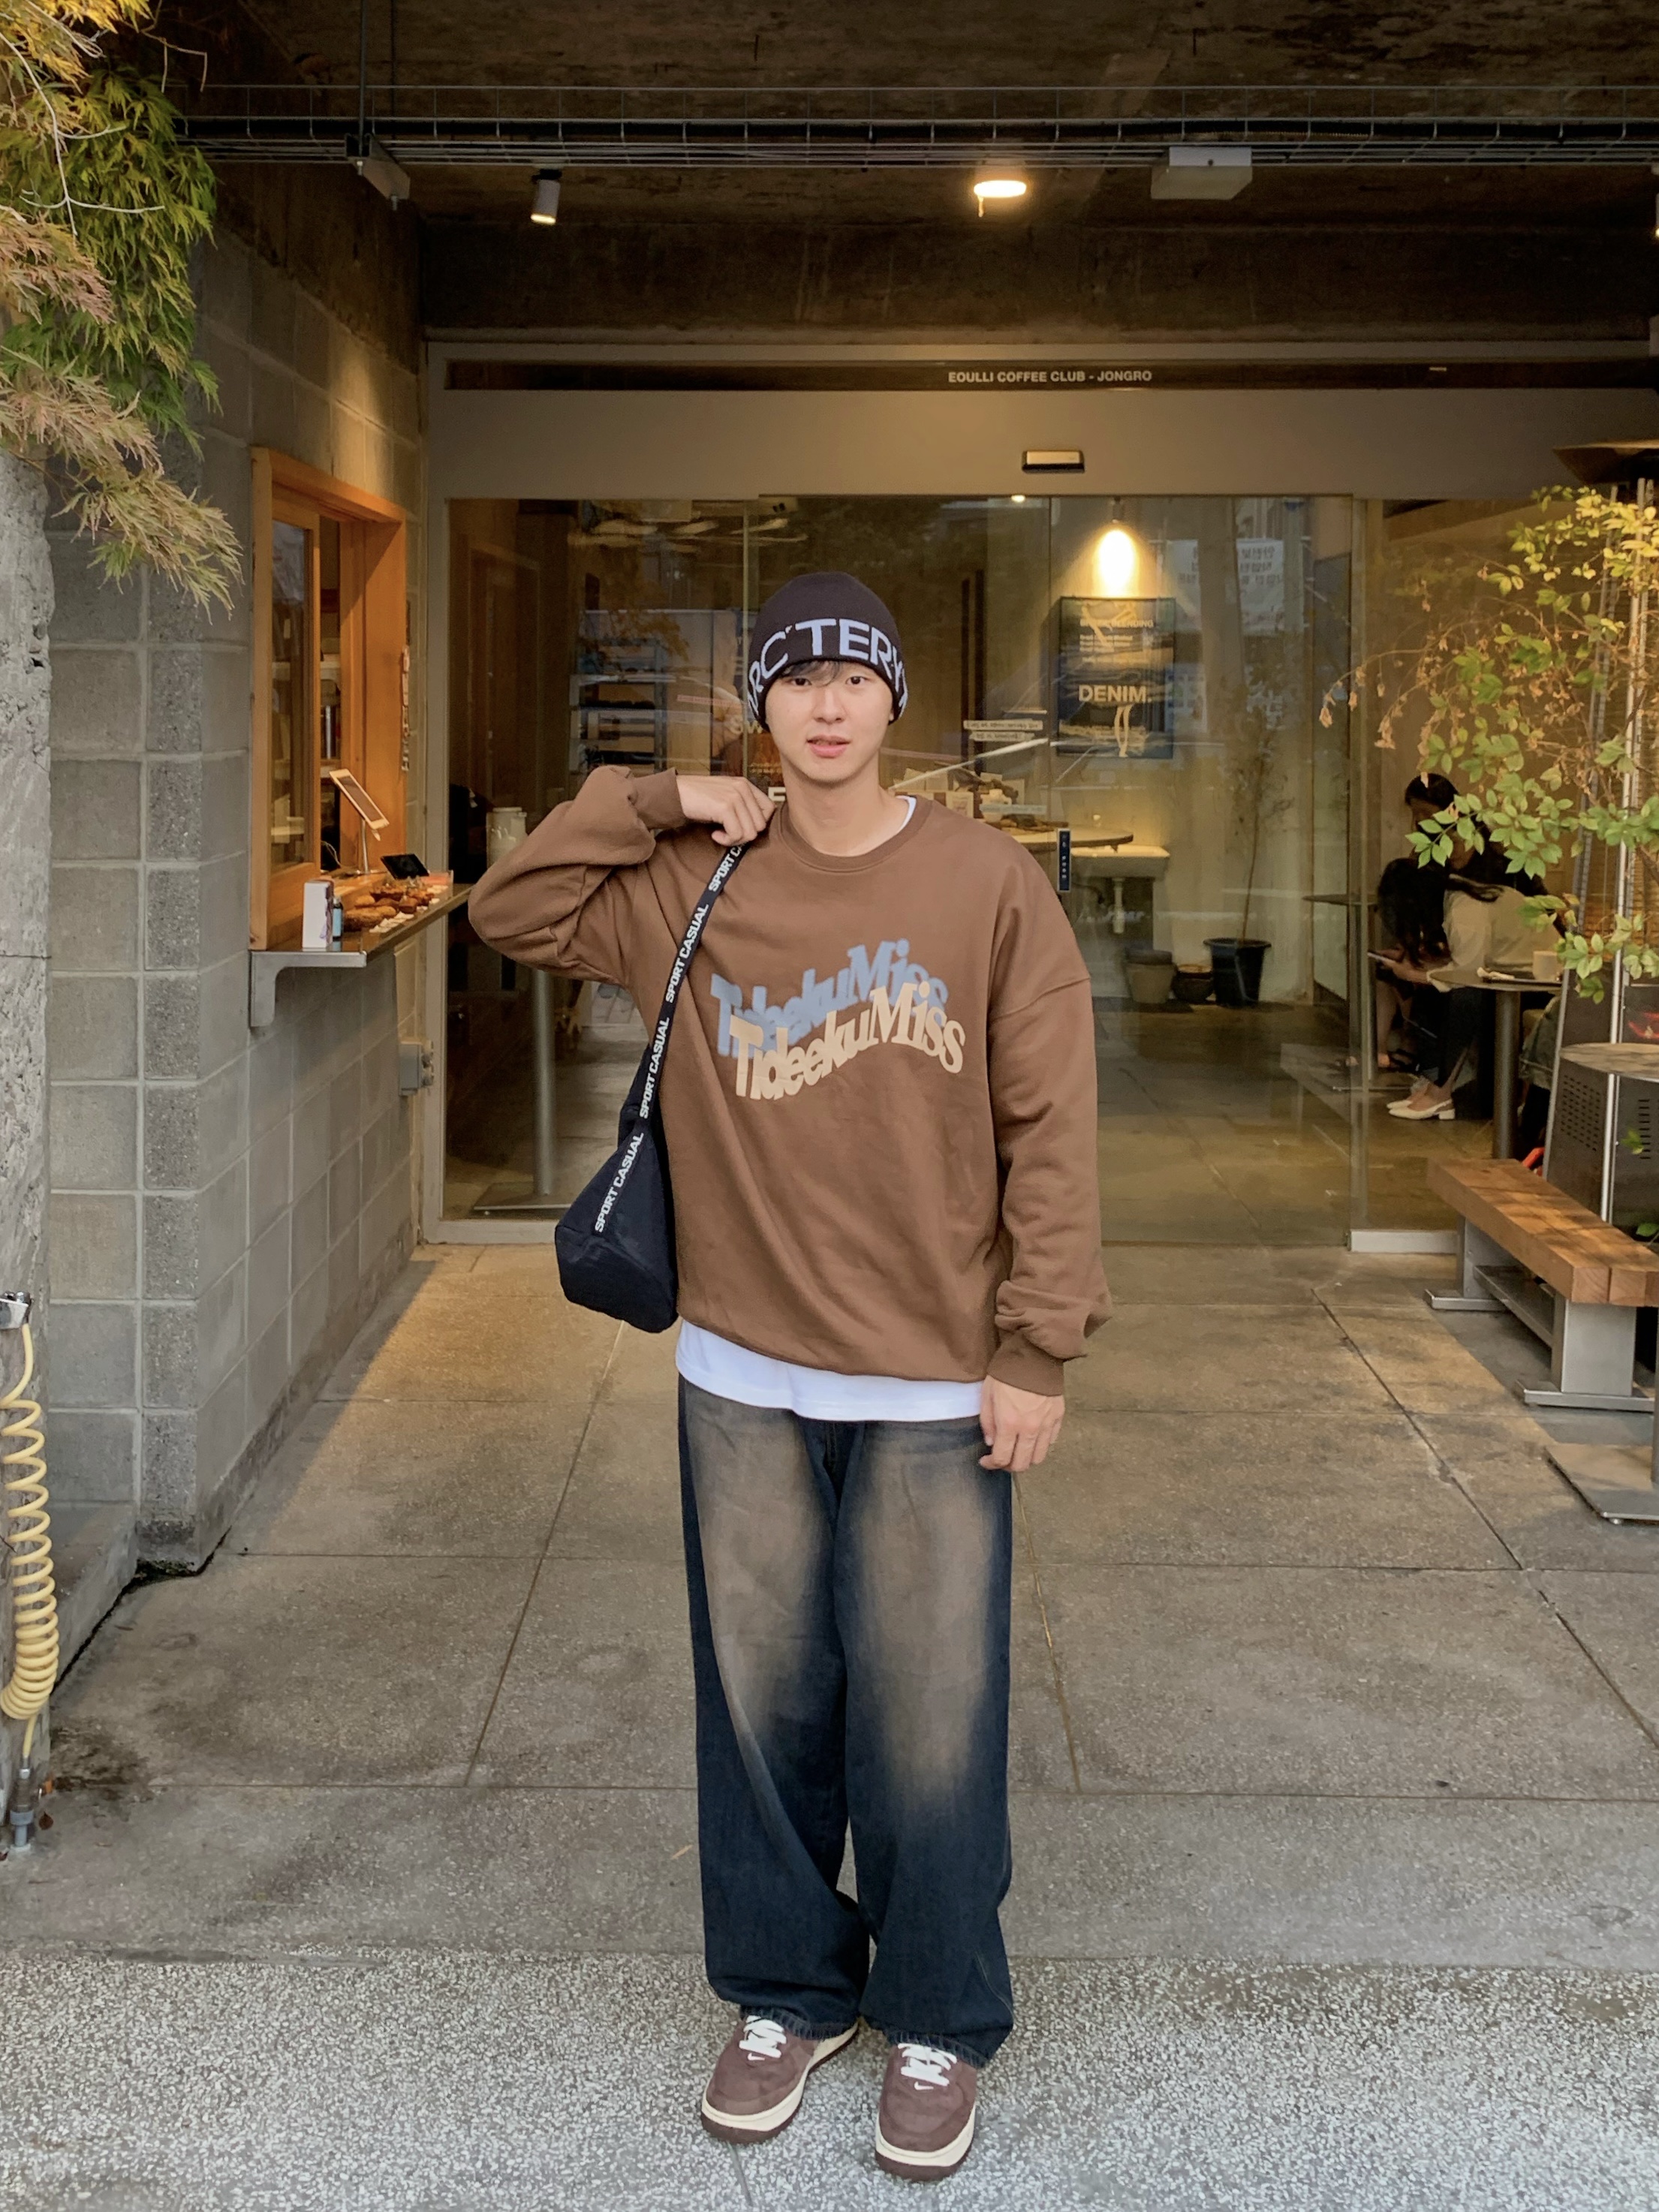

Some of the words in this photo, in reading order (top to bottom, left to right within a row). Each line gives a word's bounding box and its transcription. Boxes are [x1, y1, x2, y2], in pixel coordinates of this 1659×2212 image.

[948, 372, 994, 383] EOULLI
[997, 371, 1047, 383] COFFEE
[1050, 371, 1085, 382] CLUB
[1097, 370, 1152, 381] JONGRO
[1078, 684, 1152, 704] DENIM.
[708, 853, 735, 892] SPORT
[665, 957, 685, 1004] SPORT
[679, 904, 709, 959] CASUAL
[639, 1073, 658, 1119] SPORT
[649, 1016, 670, 1074] CASUAL
[595, 1186, 619, 1232] SPORT
[613, 1132, 644, 1187] CASUAL
